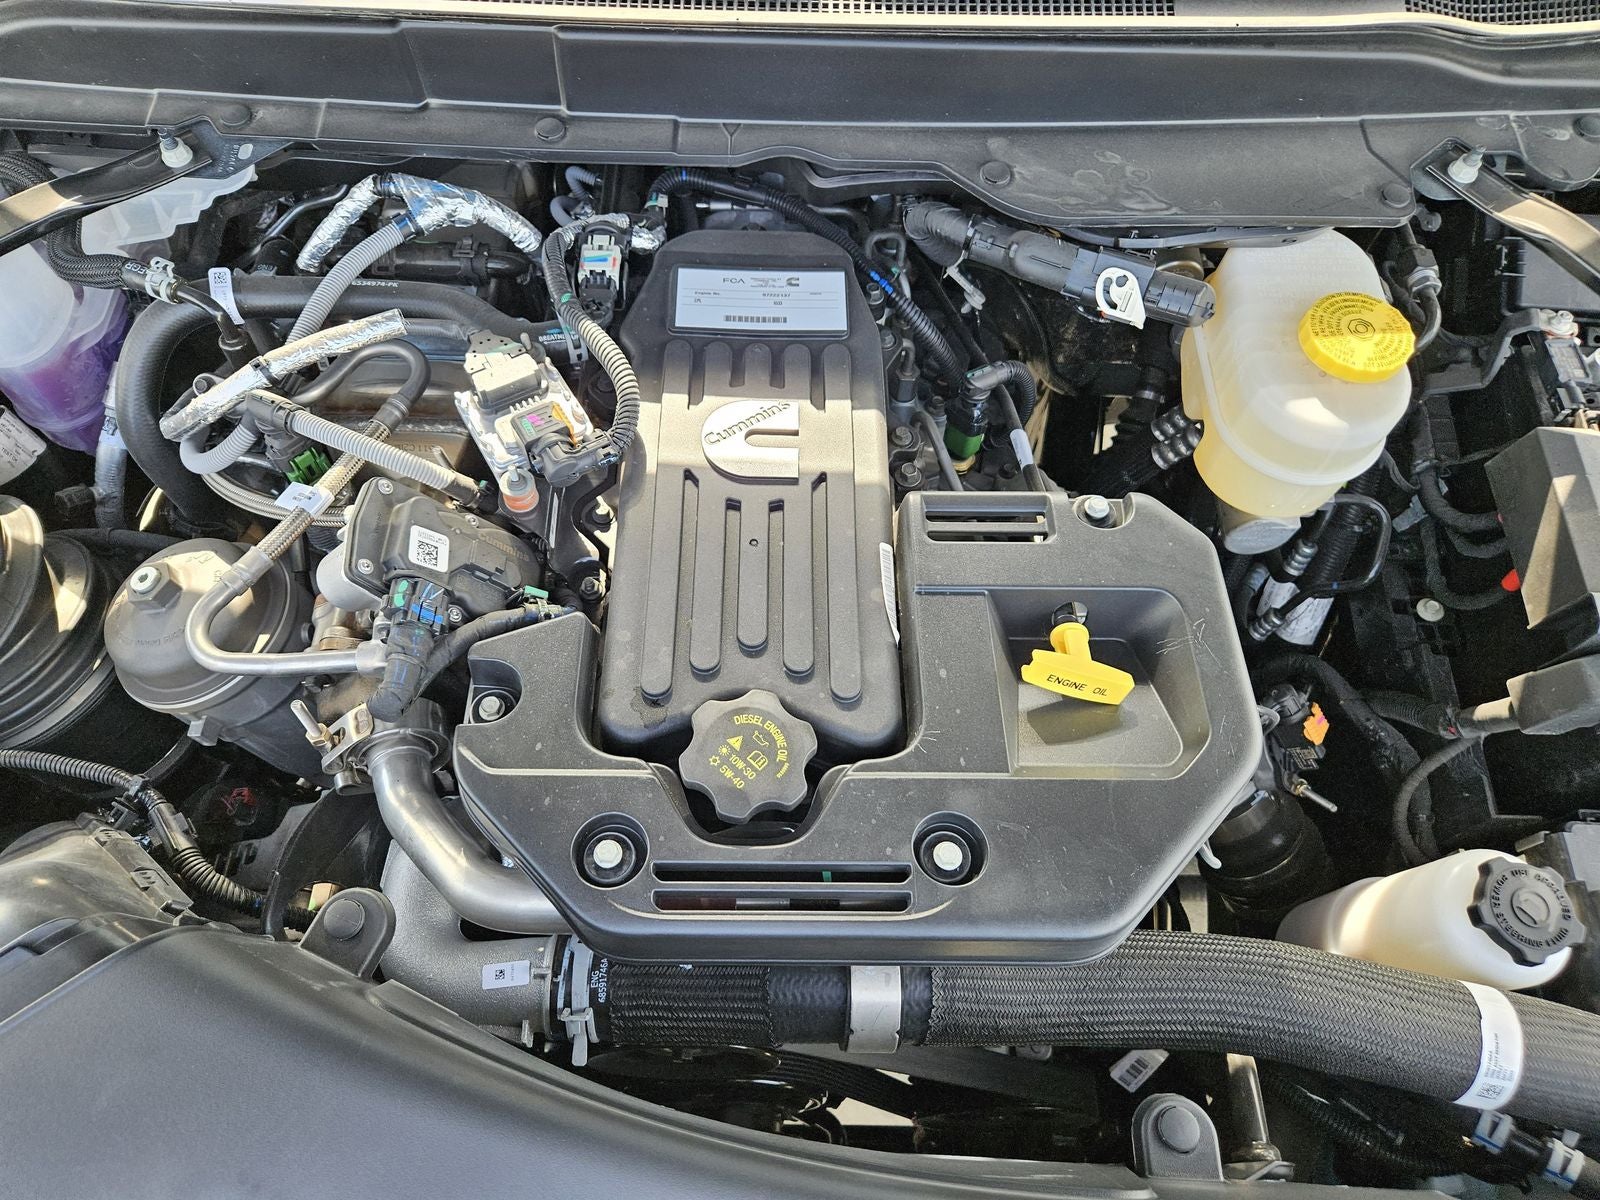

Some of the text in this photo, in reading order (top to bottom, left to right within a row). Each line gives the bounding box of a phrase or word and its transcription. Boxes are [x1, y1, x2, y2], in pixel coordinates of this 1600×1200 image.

[704, 402, 791, 445] Cummins
[1046, 674, 1108, 697] ENGINE OIL
[733, 714, 763, 727] DIESEL
[763, 720, 788, 749] ENGINE
[776, 749, 788, 763] OIL
[719, 765, 745, 789] 5W-40
[729, 753, 757, 780] 10W-30
[1496, 911, 1543, 947] STEERING
[590, 970, 599, 988] ENG
[598, 958, 608, 1003] 68591746A
